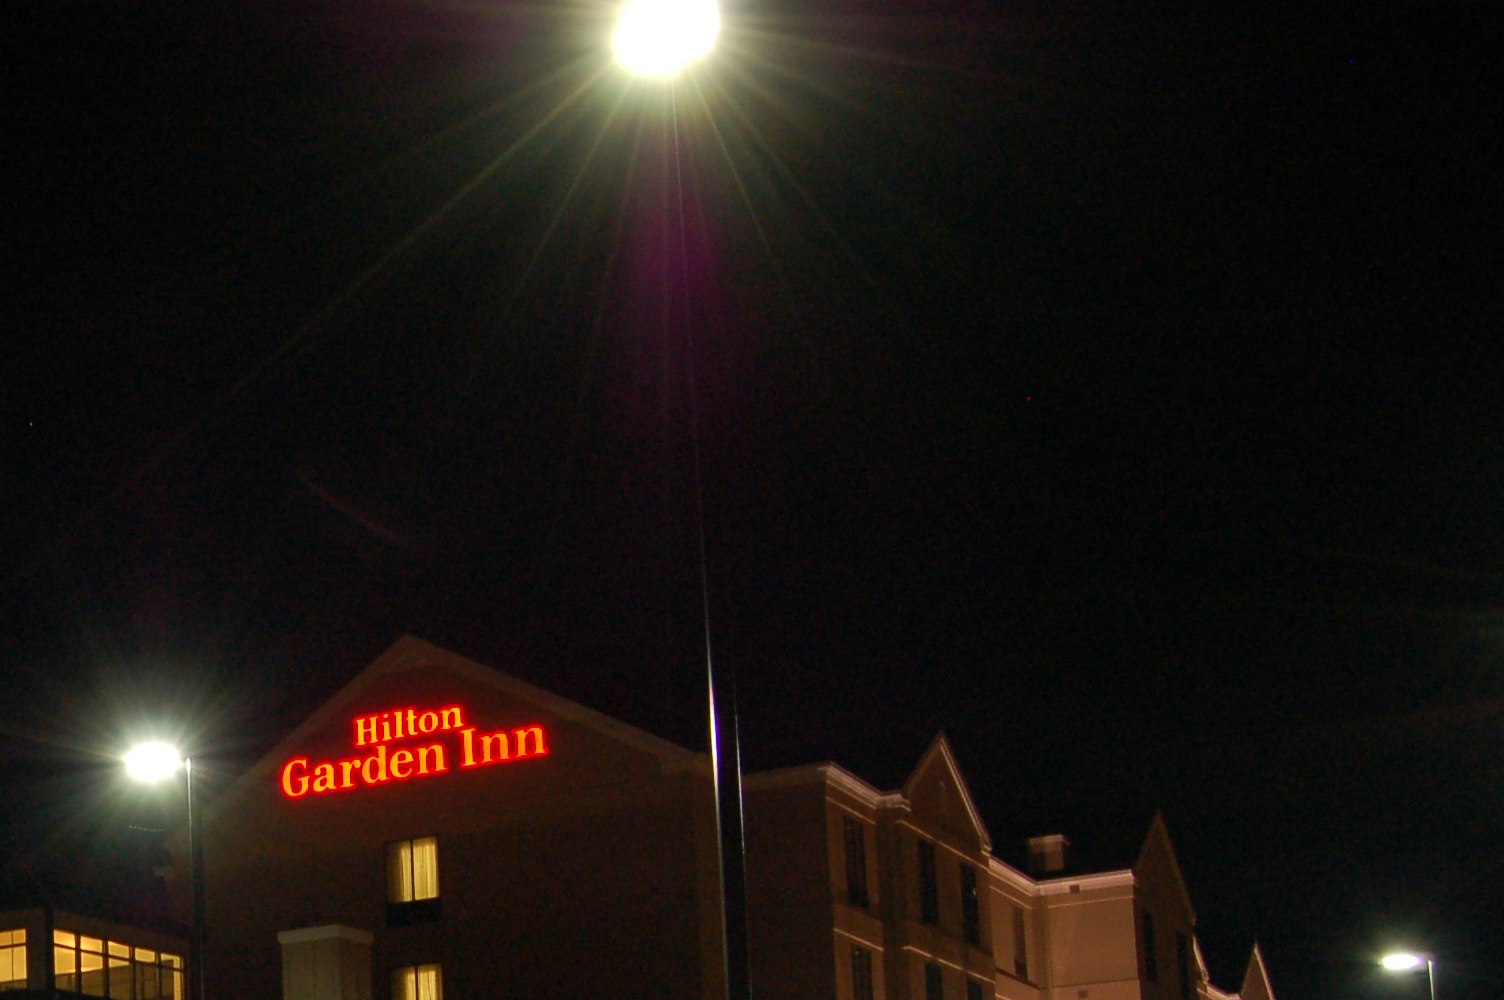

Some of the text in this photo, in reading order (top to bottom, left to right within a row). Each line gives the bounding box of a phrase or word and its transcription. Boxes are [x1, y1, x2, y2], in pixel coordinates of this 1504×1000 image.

[353, 704, 466, 746] Hilton
[280, 723, 550, 799] Garden Inn
